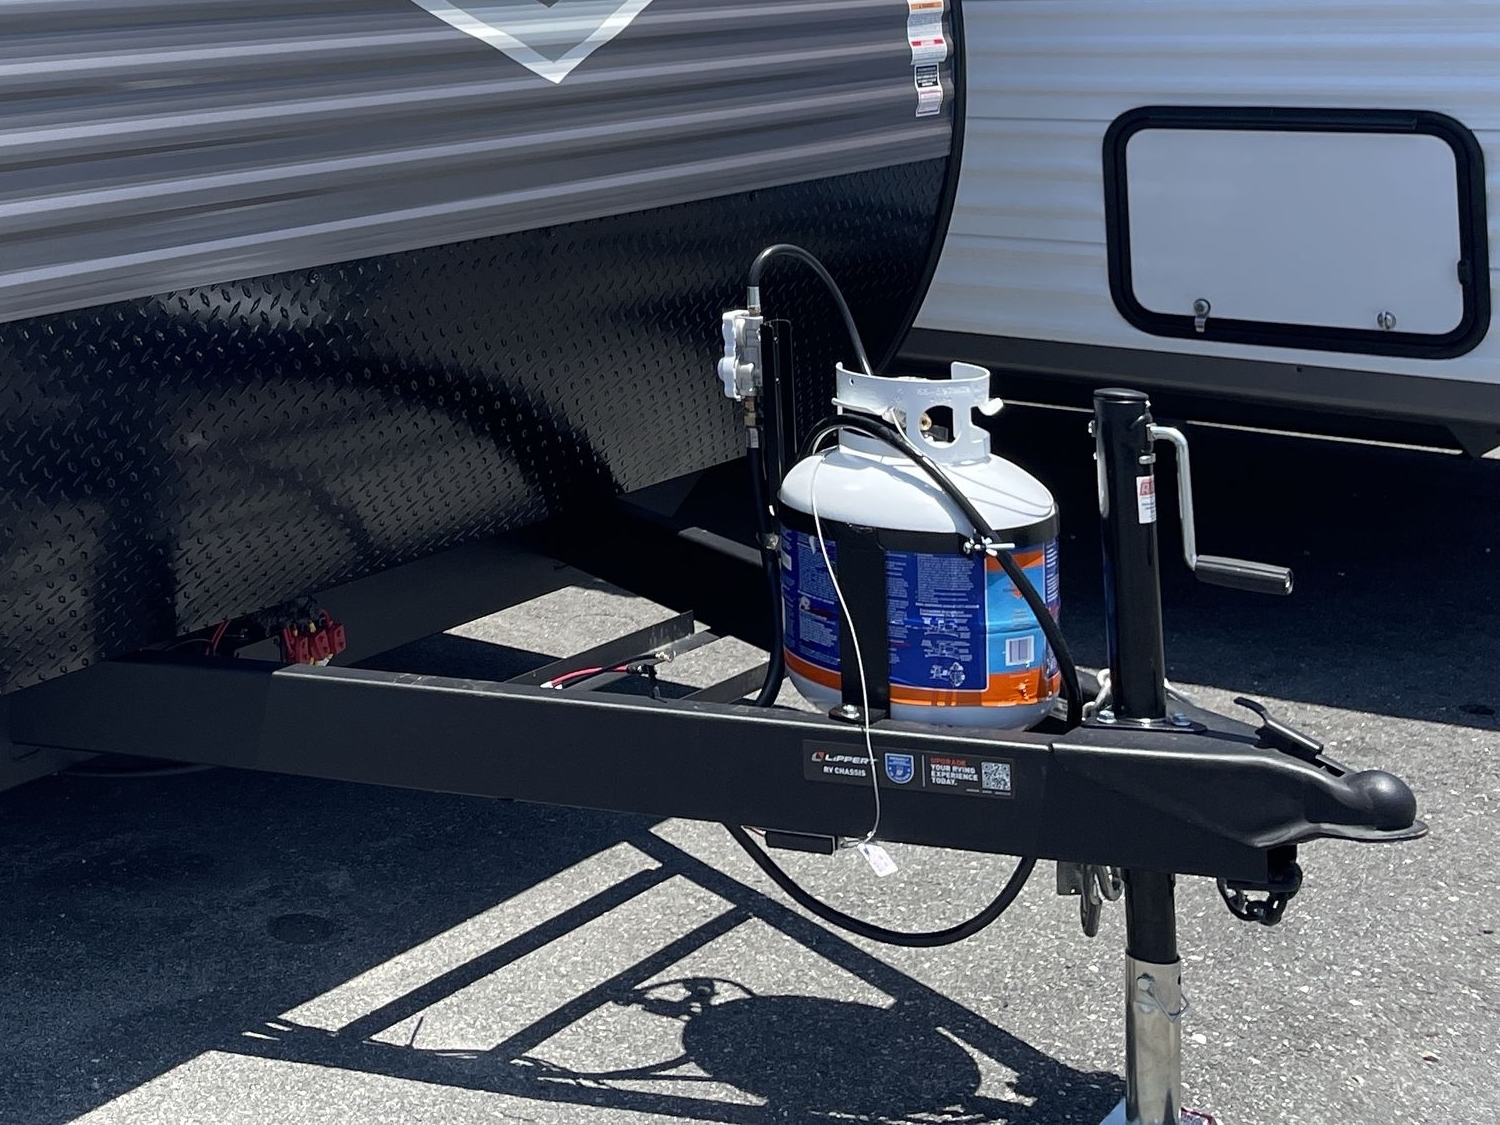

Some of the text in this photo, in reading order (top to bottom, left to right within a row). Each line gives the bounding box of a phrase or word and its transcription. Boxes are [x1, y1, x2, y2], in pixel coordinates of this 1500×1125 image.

[823, 766, 867, 777] RV CHASSIS
[931, 764, 950, 772] YOUR
[930, 771, 979, 782] EXPERIENCE
[931, 777, 957, 786] TODAY.
